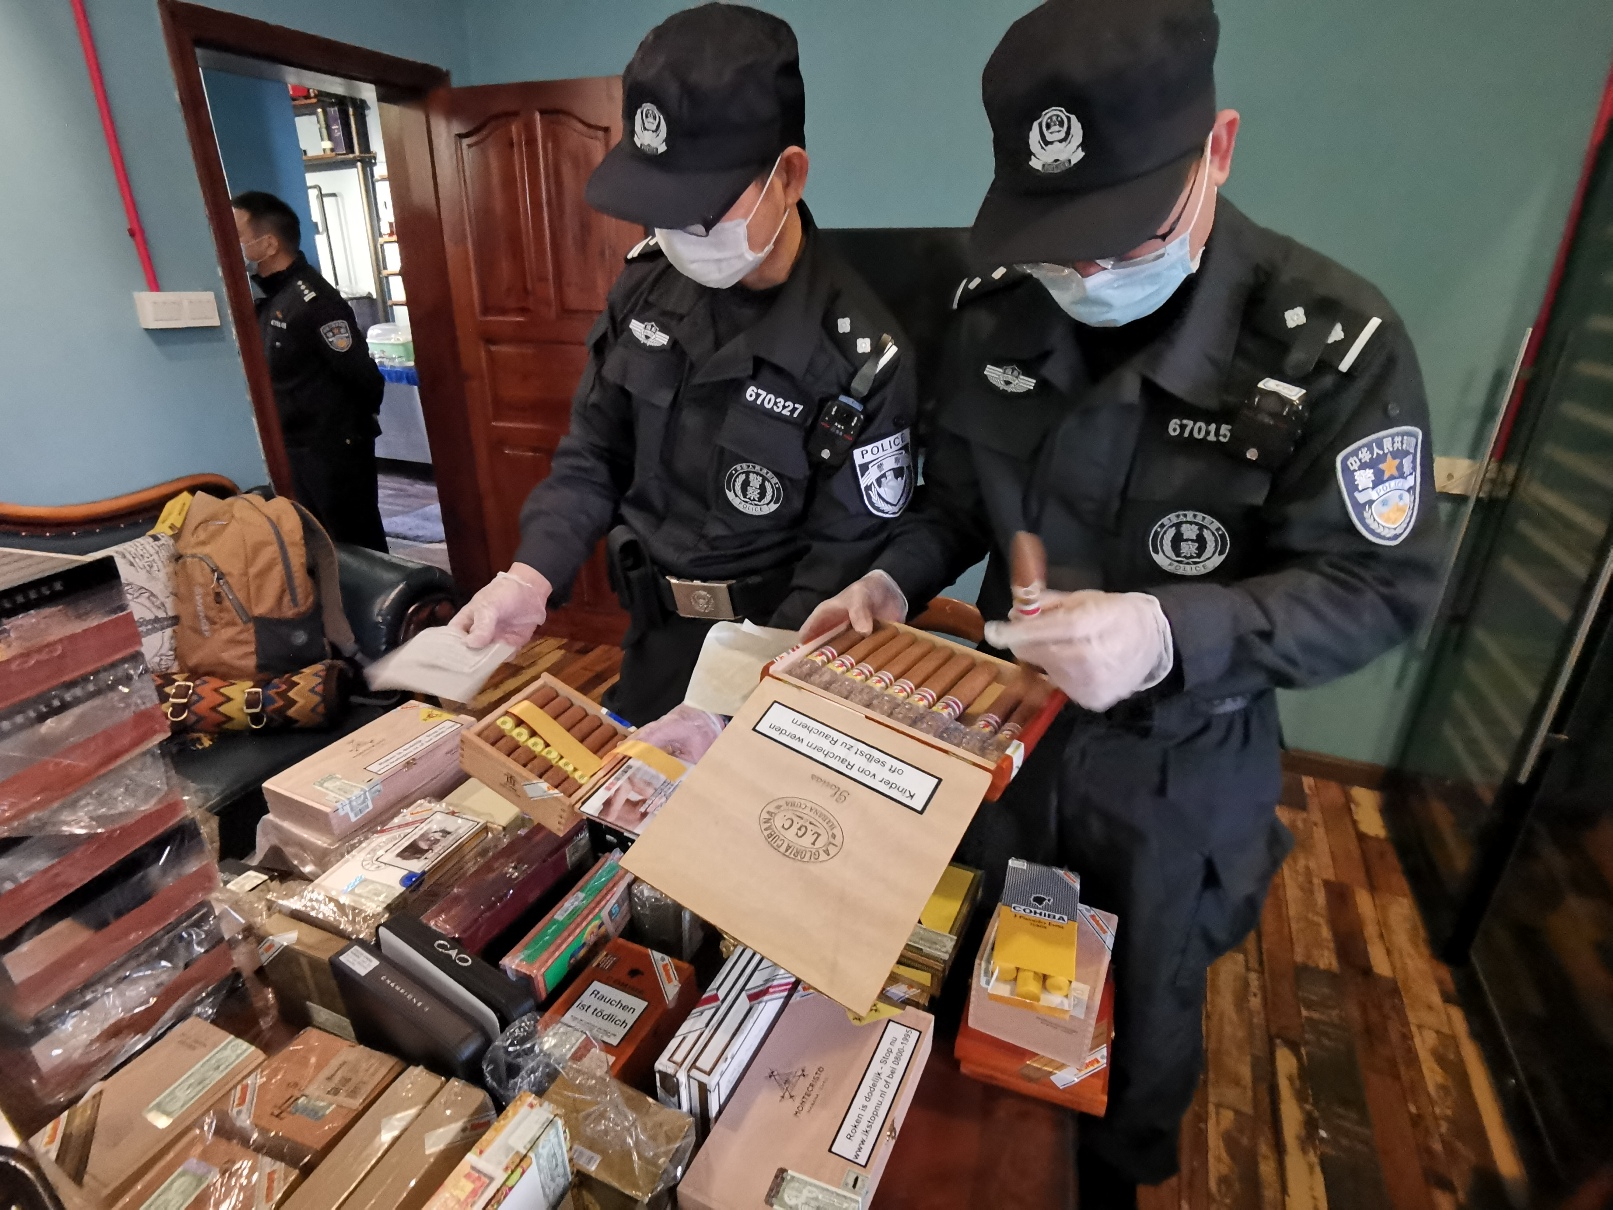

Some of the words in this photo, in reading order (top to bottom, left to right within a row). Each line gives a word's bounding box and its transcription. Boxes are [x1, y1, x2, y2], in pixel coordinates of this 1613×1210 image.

[745, 385, 804, 418] 670327
[1168, 418, 1232, 442] 67015
[860, 432, 906, 459] POLICE
[746, 472, 763, 501] 警察
[1180, 523, 1200, 557] 警察
[1167, 562, 1209, 574] POLICE
[768, 722, 805, 745] werden
[791, 717, 840, 747] Rauchern
[805, 741, 855, 772] Rauchern
[840, 740, 855, 752] zu
[853, 747, 888, 769] selbst
[857, 766, 878, 781] von
[887, 763, 905, 777] oft
[878, 777, 917, 801] Kinder
[762, 810, 786, 849] CUBANA
[784, 843, 821, 861] GLORIA
[822, 841, 839, 857] LA
[1012, 905, 1067, 923] COHIBA
[433, 940, 472, 967] CAO
[589, 988, 637, 1015] Rauchen
[575, 1001, 592, 1014] ist
[591, 1007, 629, 1030] tödlich
[883, 1079, 892, 1090] of
[892, 1029, 913, 1066] 0800-1995
[793, 1066, 825, 1118] MONTECRISTO
[846, 1113, 865, 1141] Roken
[858, 1103, 868, 1112] is
[865, 1071, 883, 1103] dodelijk
[880, 1047, 894, 1065] Stop
[889, 1036, 898, 1046] nu
